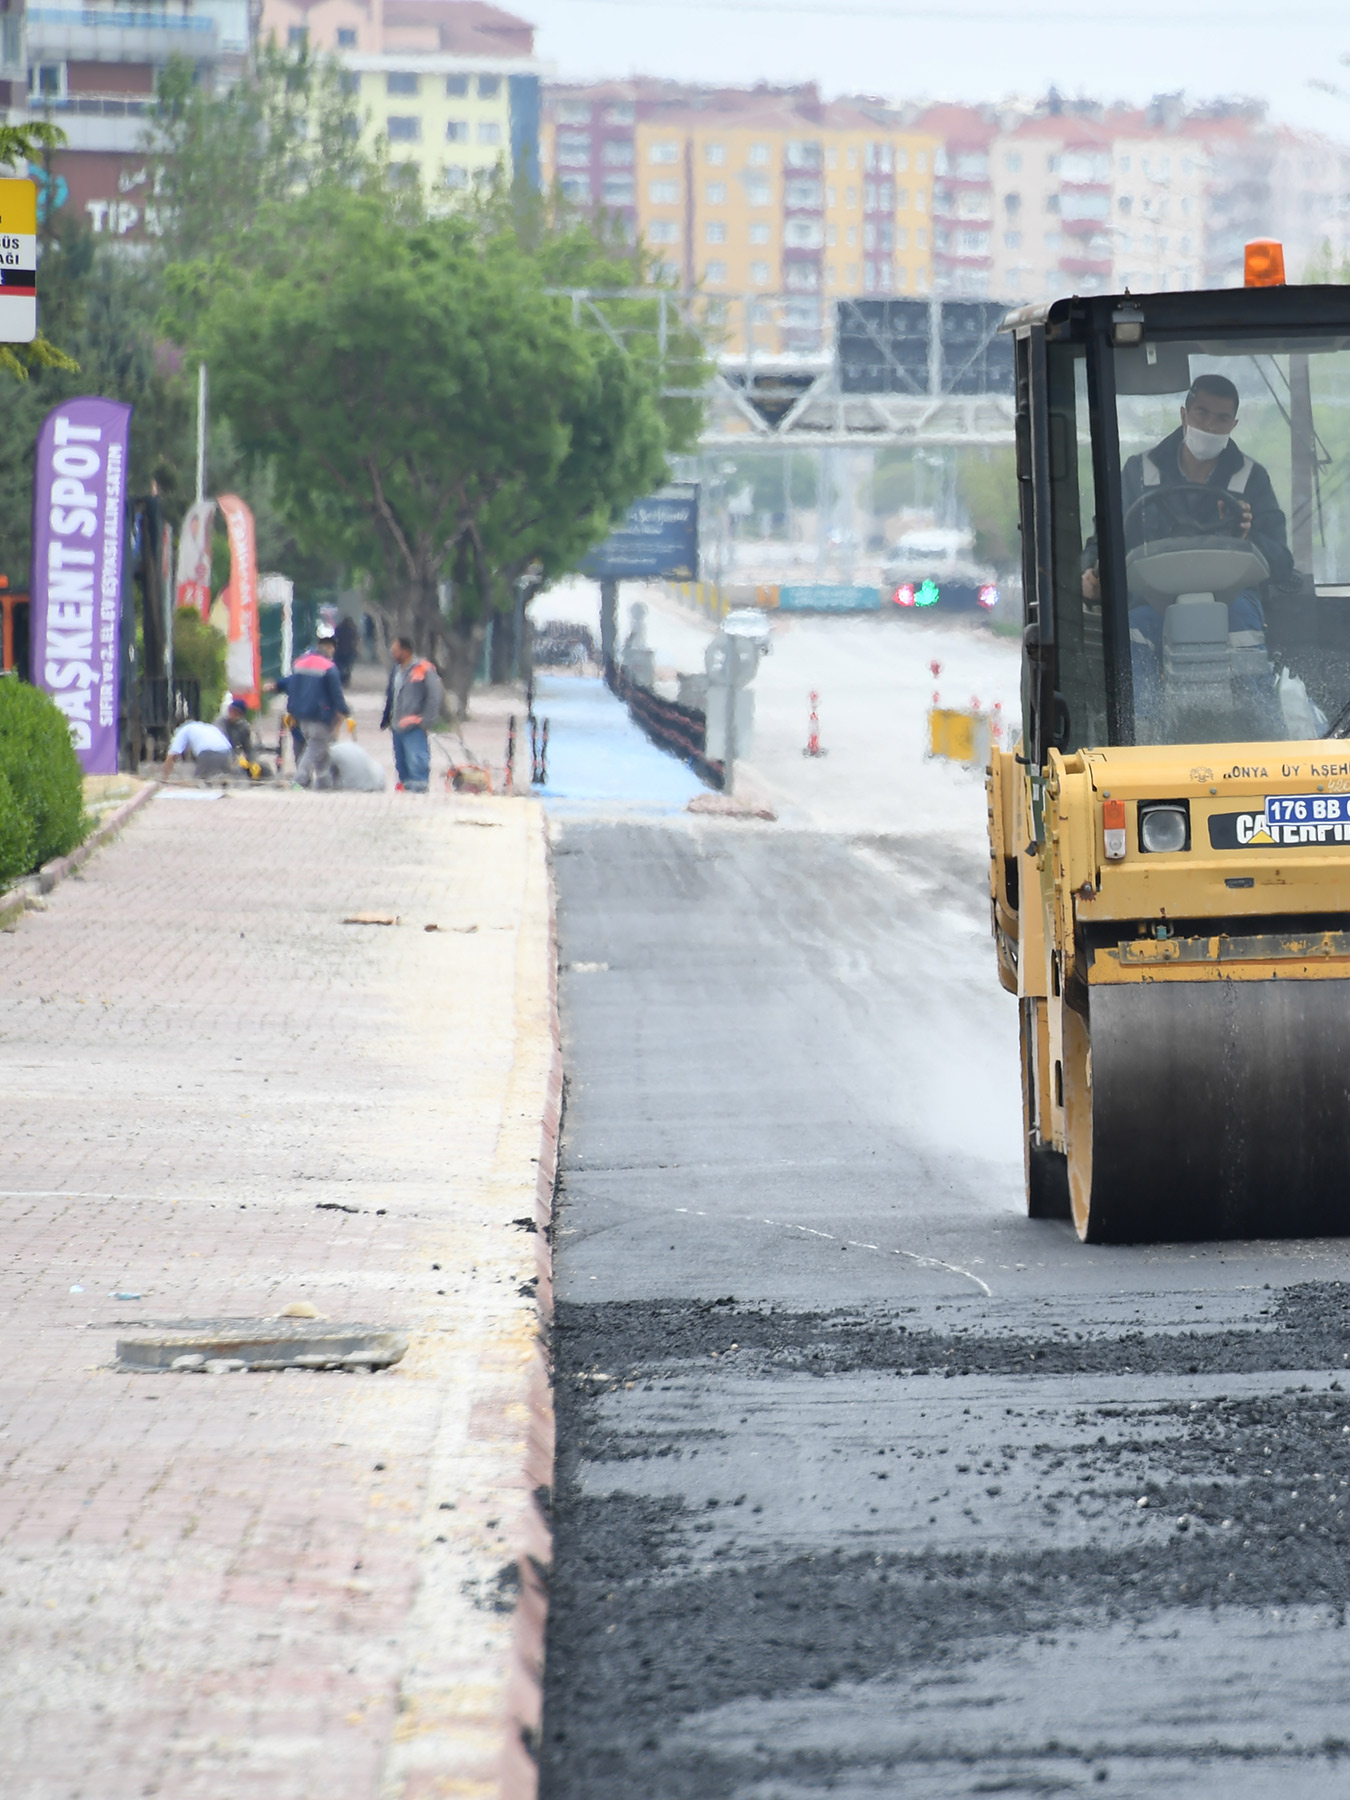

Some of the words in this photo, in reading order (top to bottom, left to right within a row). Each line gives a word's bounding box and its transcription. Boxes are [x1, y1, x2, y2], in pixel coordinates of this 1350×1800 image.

[0, 236, 19, 250] ÜS
[50, 416, 102, 539] SPOT
[1270, 801, 1307, 820] 176
[1313, 800, 1341, 818] BB
